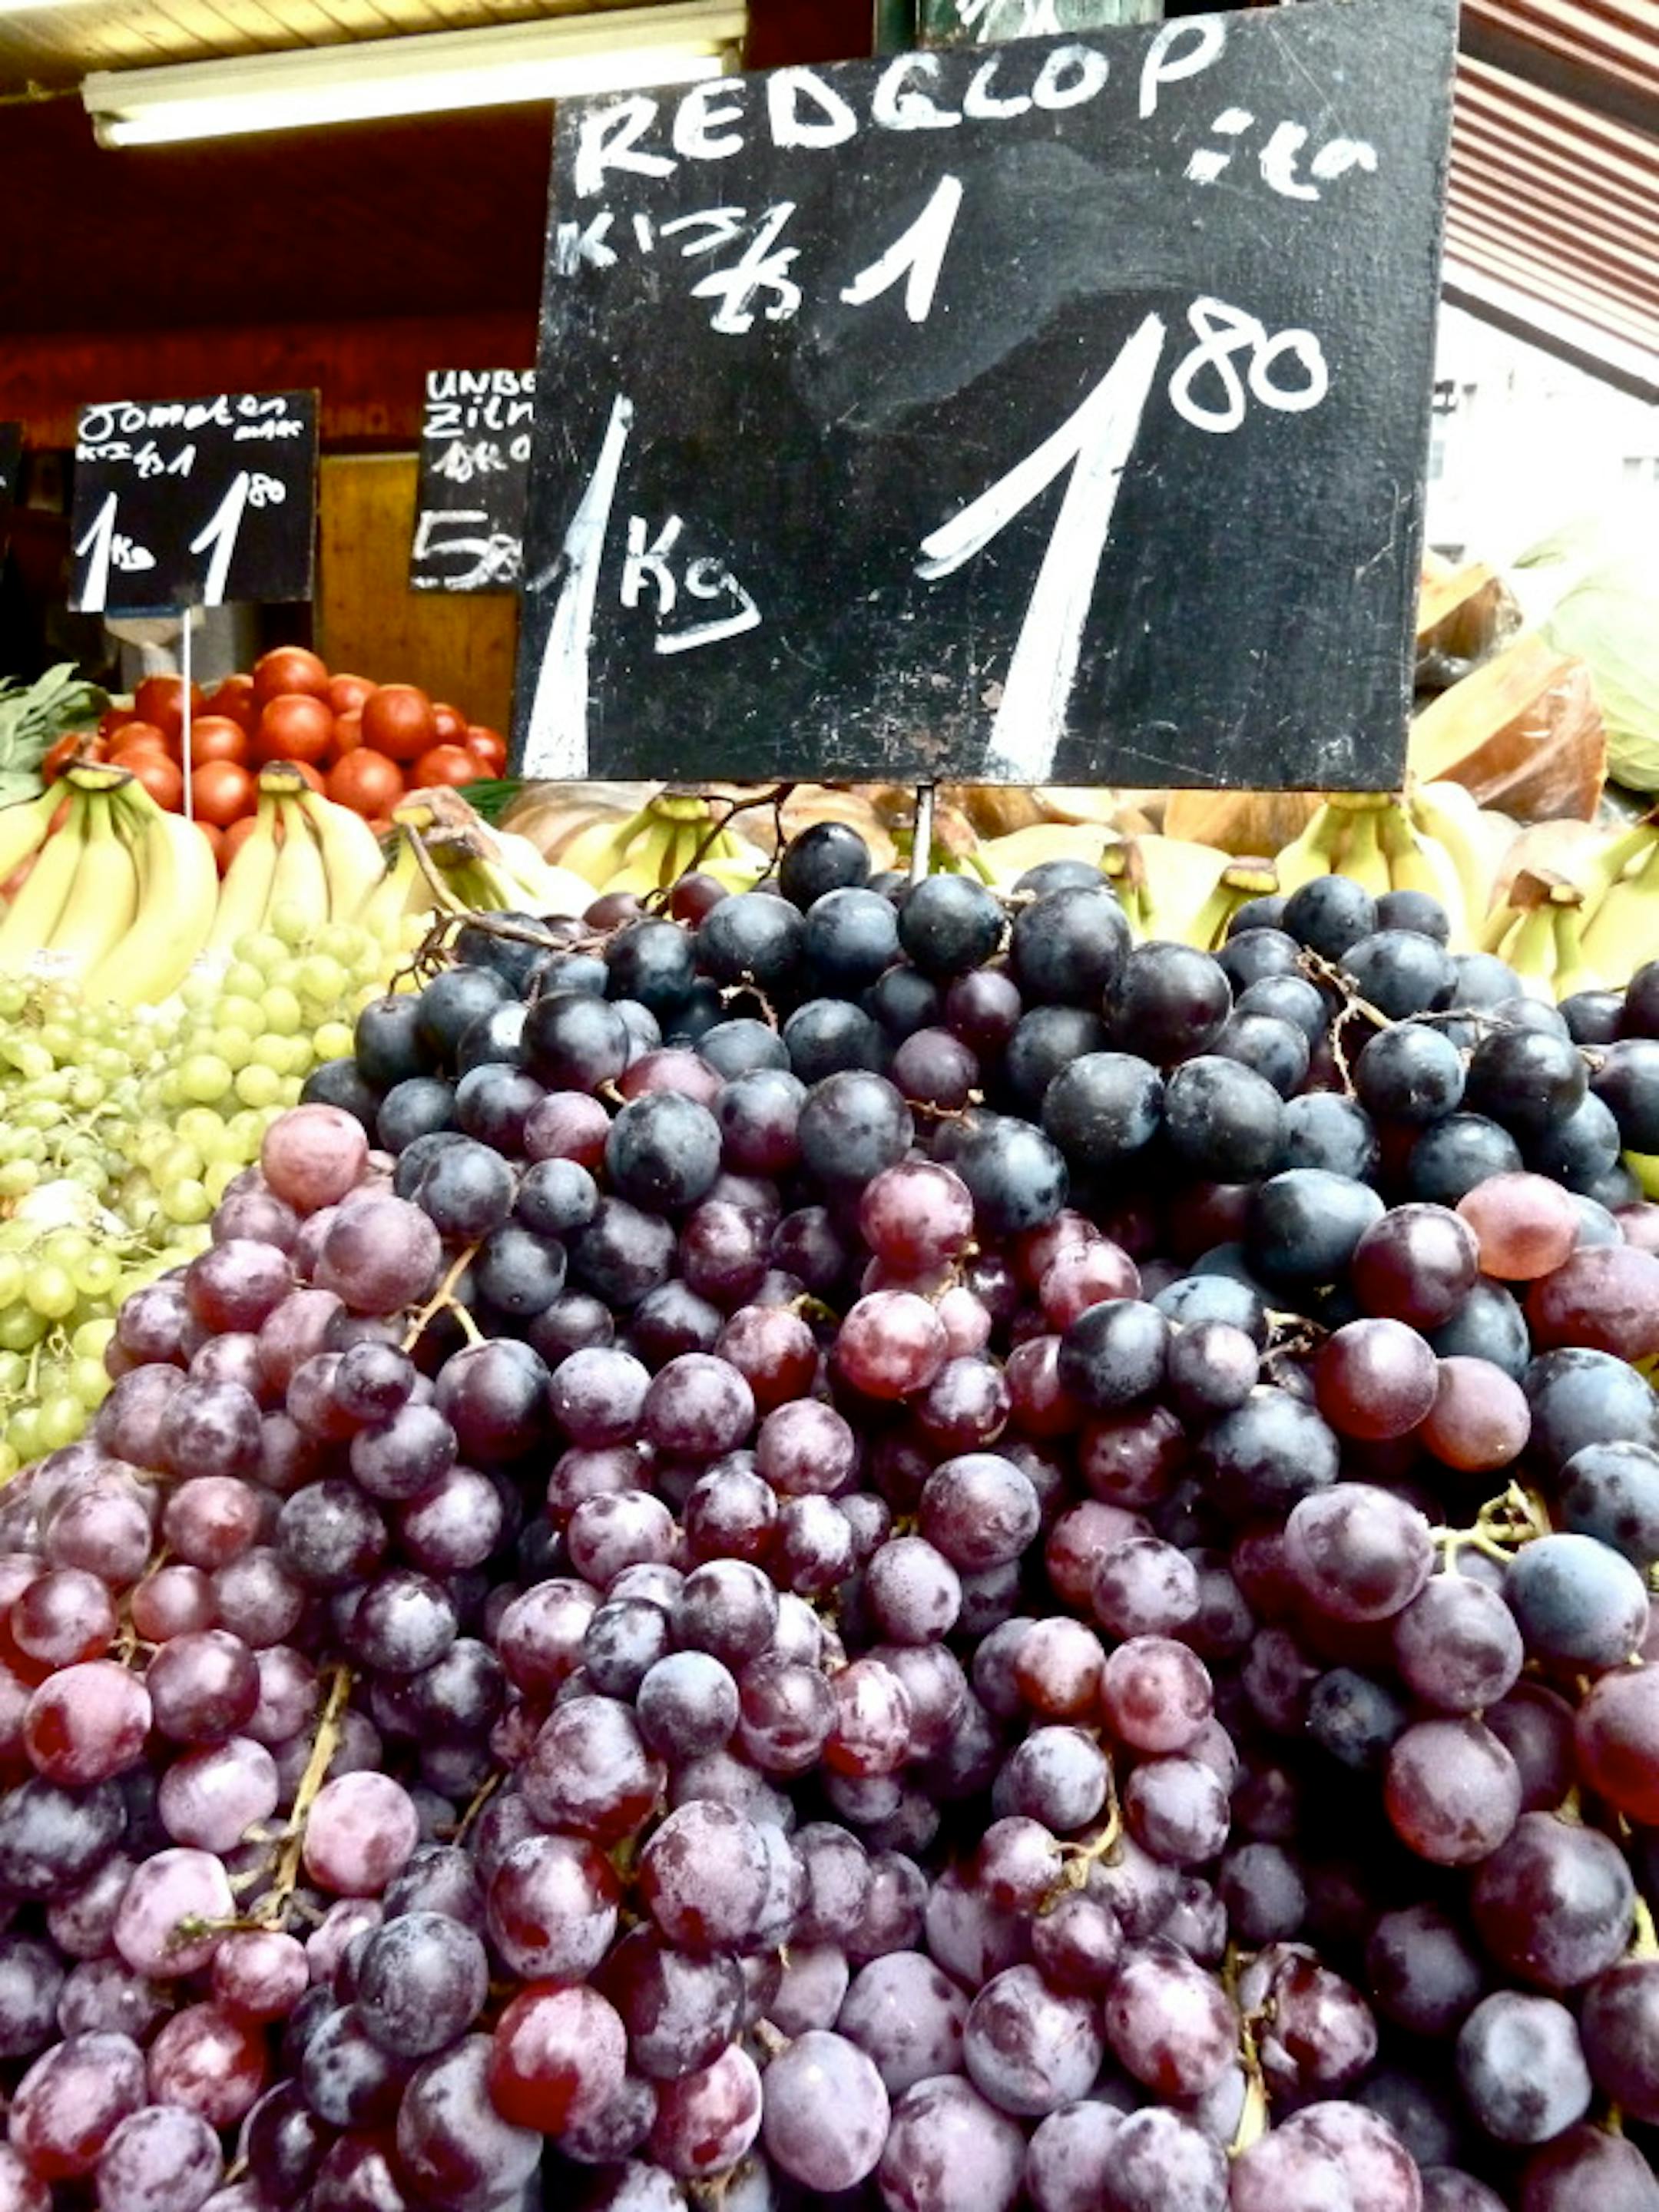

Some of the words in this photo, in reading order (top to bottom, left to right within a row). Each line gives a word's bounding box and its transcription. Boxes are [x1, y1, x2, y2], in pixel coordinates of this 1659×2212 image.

[189, 469, 250, 607] 1
[248, 472, 286, 508] 80
[620, 514, 762, 654] Kg
[915, 311, 1166, 783] 1
[1168, 295, 1329, 433] 80
